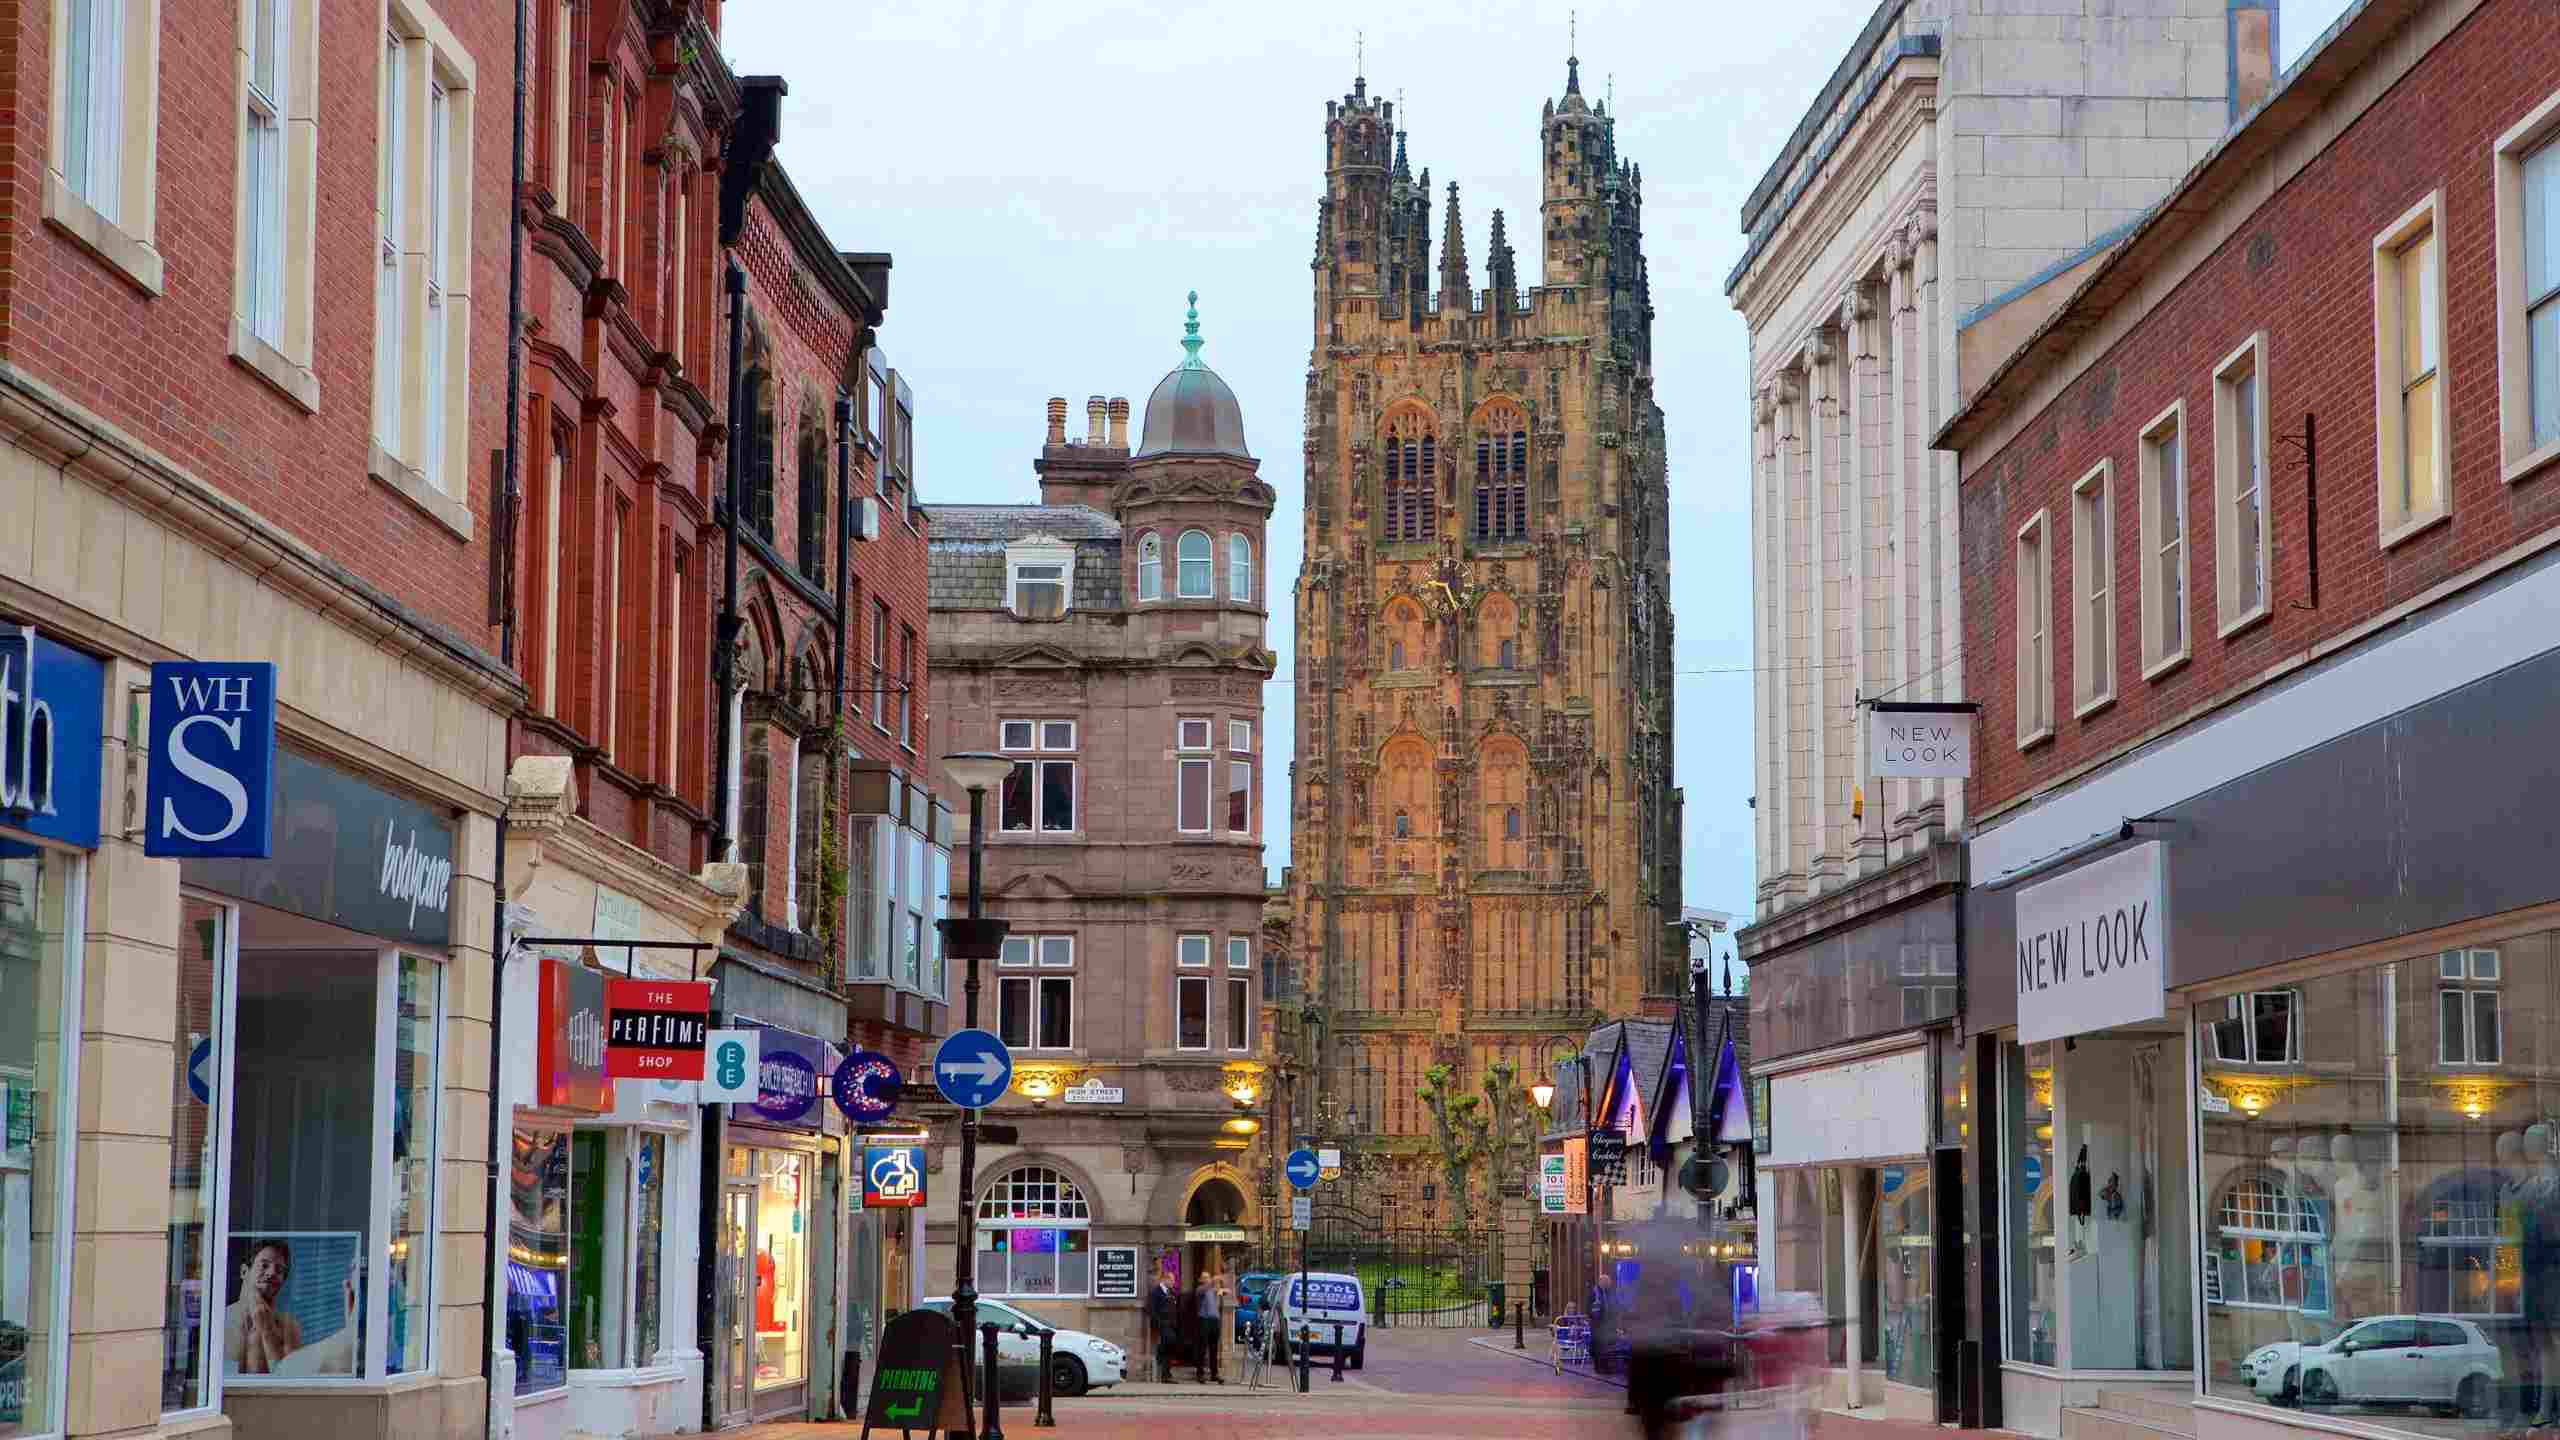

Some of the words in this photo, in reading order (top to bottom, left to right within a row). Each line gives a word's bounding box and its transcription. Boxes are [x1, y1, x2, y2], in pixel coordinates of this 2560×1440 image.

[168, 676, 253, 713] WH
[1889, 726, 1953, 742] NEW
[1884, 746, 1958, 763] LOOK
[161, 714, 249, 842] S
[380, 818, 451, 931] bodycare
[2018, 925, 2070, 993] NEW
[2080, 900, 2150, 979] LOOK
[648, 992, 673, 1004] THE
[612, 1014, 704, 1045] PERFUME
[639, 1055, 673, 1068] SHOP
